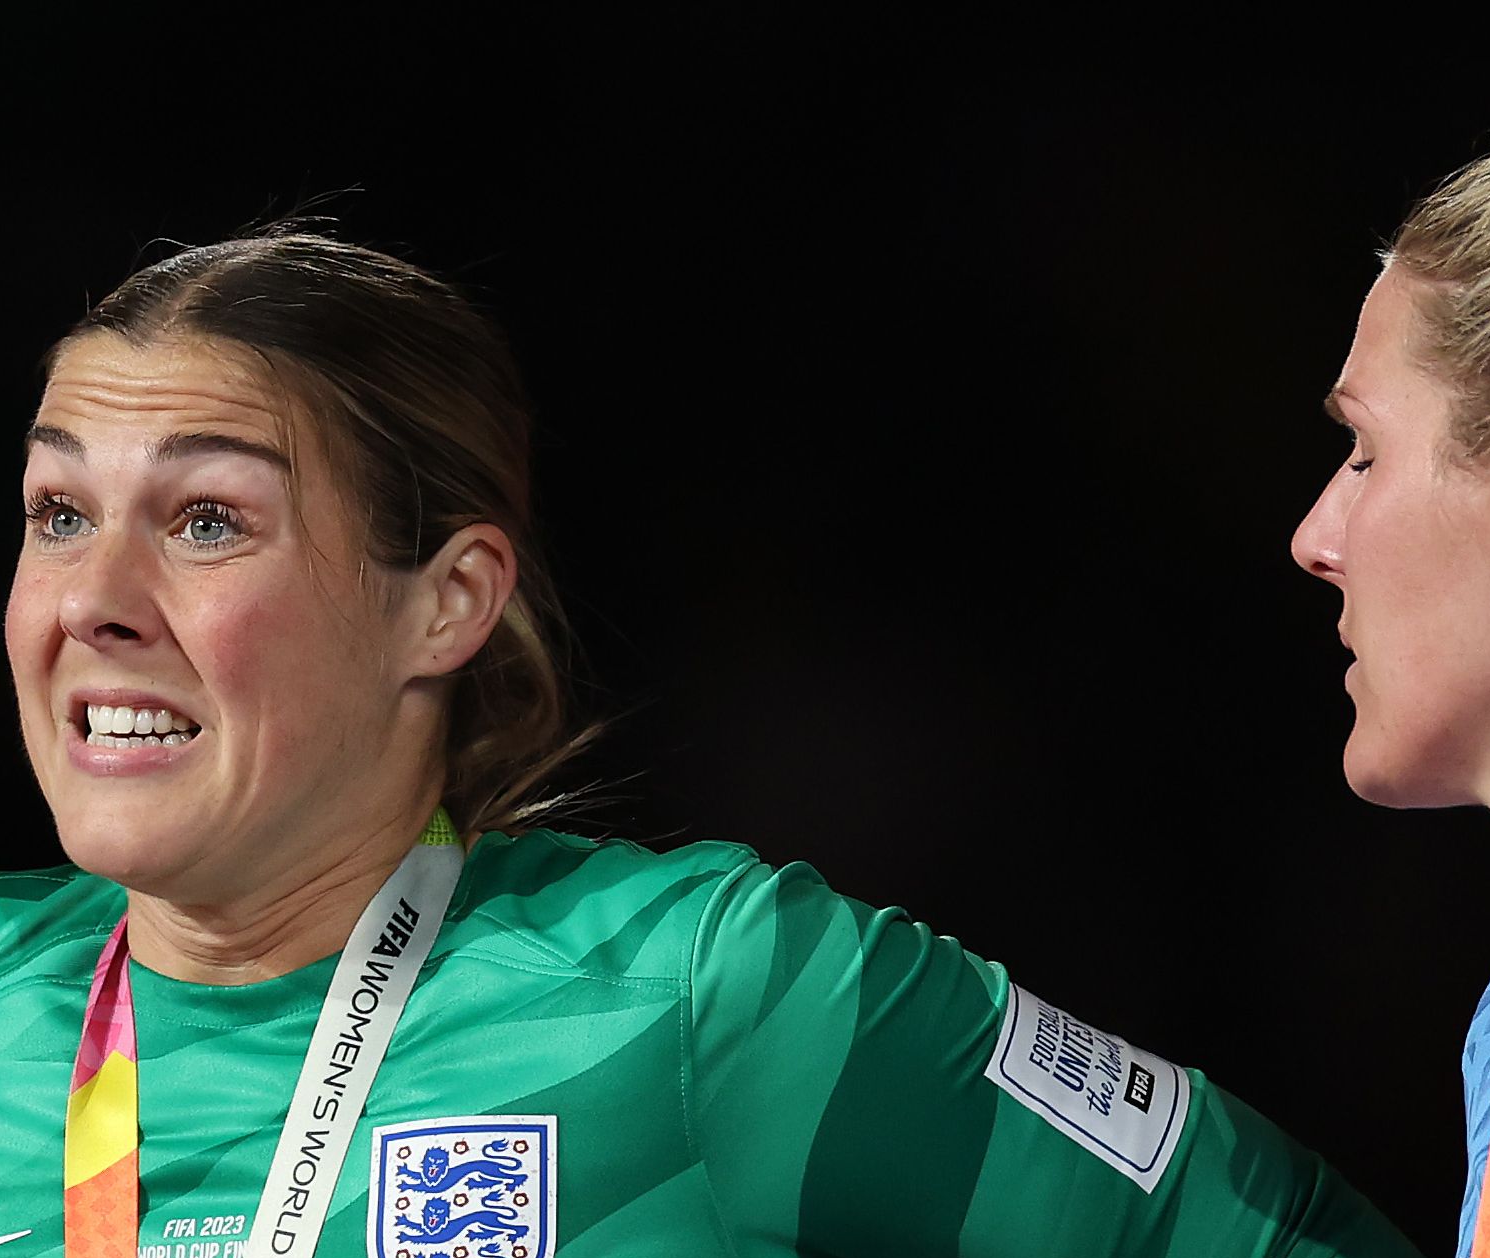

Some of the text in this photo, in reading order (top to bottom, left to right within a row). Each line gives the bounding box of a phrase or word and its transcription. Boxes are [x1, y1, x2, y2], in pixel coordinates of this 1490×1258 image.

[371, 897, 422, 961] FIFA
[312, 962, 394, 1122] WOMEN'S
[1052, 1015, 1094, 1092] UNITES
[1086, 1081, 1116, 1117] the
[1130, 1069, 1150, 1105] FIFA
[271, 1129, 330, 1255] WORLD
[162, 1215, 246, 1239] FIFA 2023
